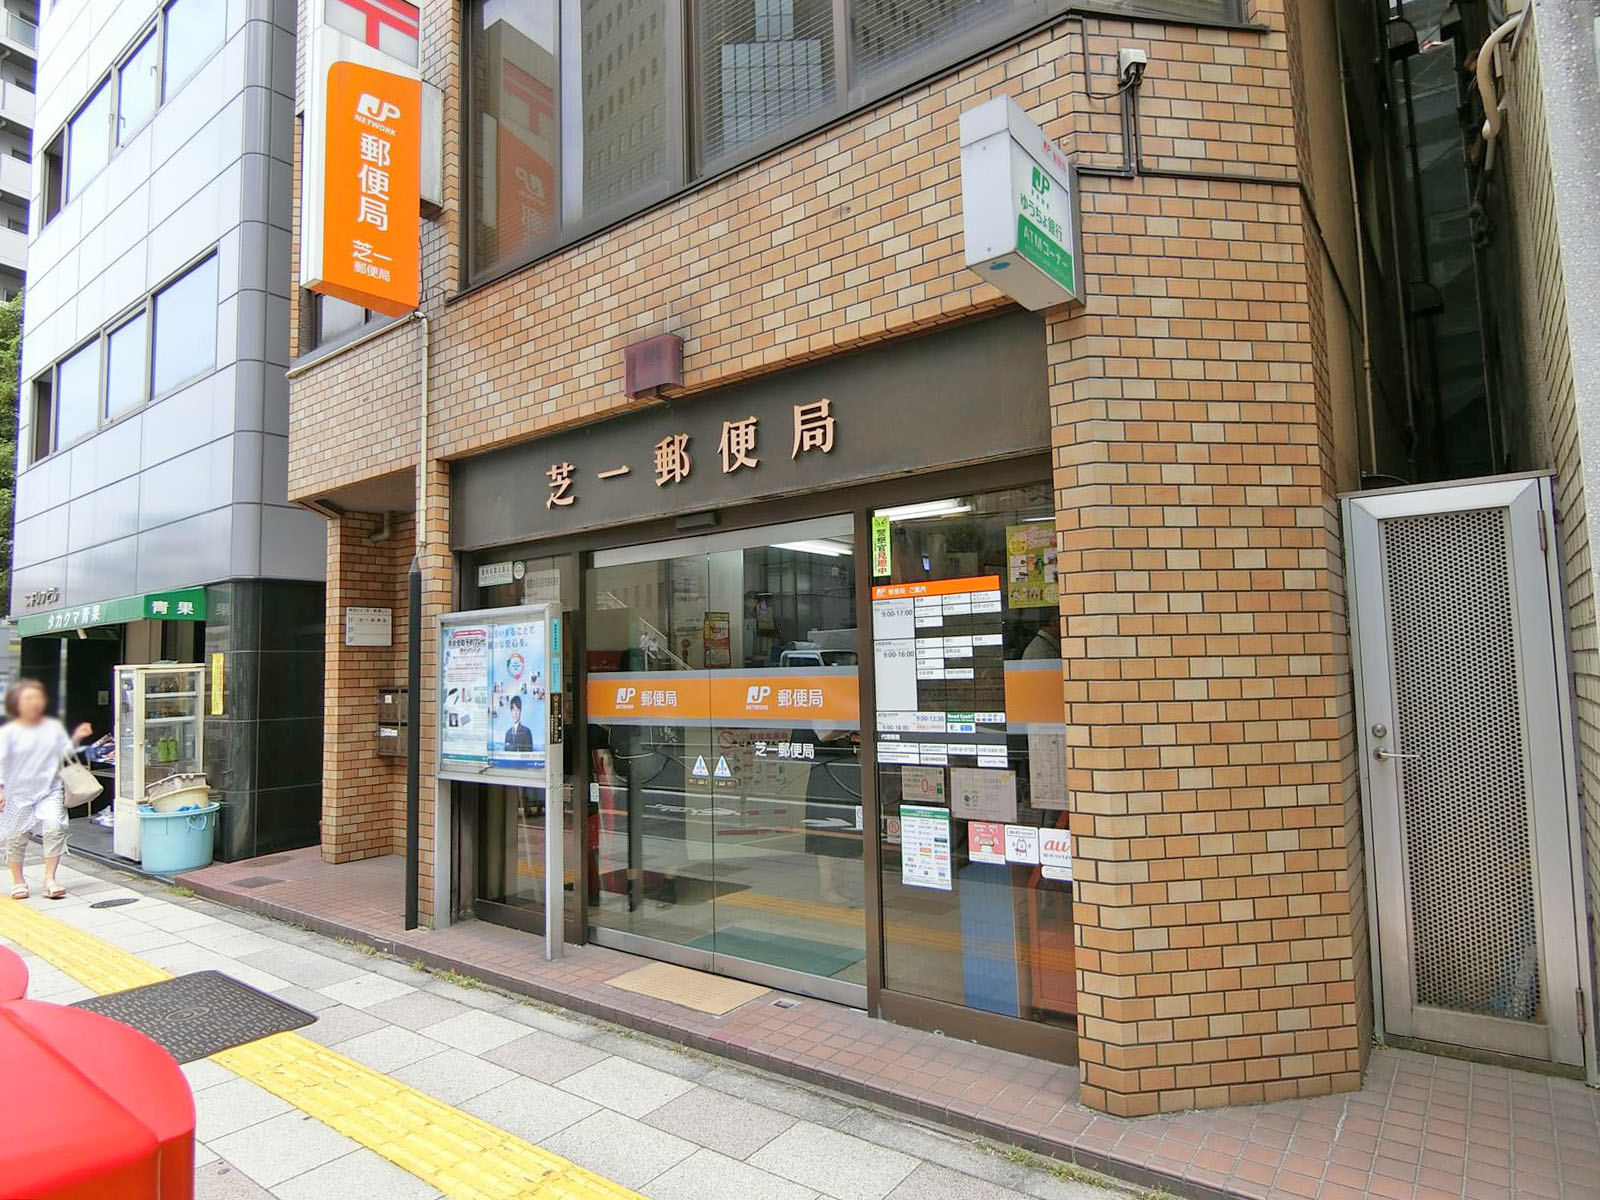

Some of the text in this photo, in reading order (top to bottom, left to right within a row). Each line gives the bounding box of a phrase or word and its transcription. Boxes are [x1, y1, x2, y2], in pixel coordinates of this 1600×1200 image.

[355, 114, 397, 137] NETWORK
[357, 132, 391, 232] 郵便局
[1020, 193, 1064, 243] ゆうちょ銀行
[352, 240, 393, 264] 芝一
[1023, 226, 1069, 268] ATMコーナー
[353, 261, 391, 283] 郵便局
[546, 397, 837, 510] 芝一郵便局
[152, 600, 195, 615] 青果
[881, 609, 913, 618] 9:00-17:00
[883, 650, 915, 658] 9:00-16:00
[616, 687, 636, 704] JP
[640, 690, 677, 708] 郵便局
[746, 685, 771, 704] JP
[777, 689, 824, 708] 郵便局
[754, 741, 815, 760] 芝一郵便局
[1043, 839, 1070, 852] au
